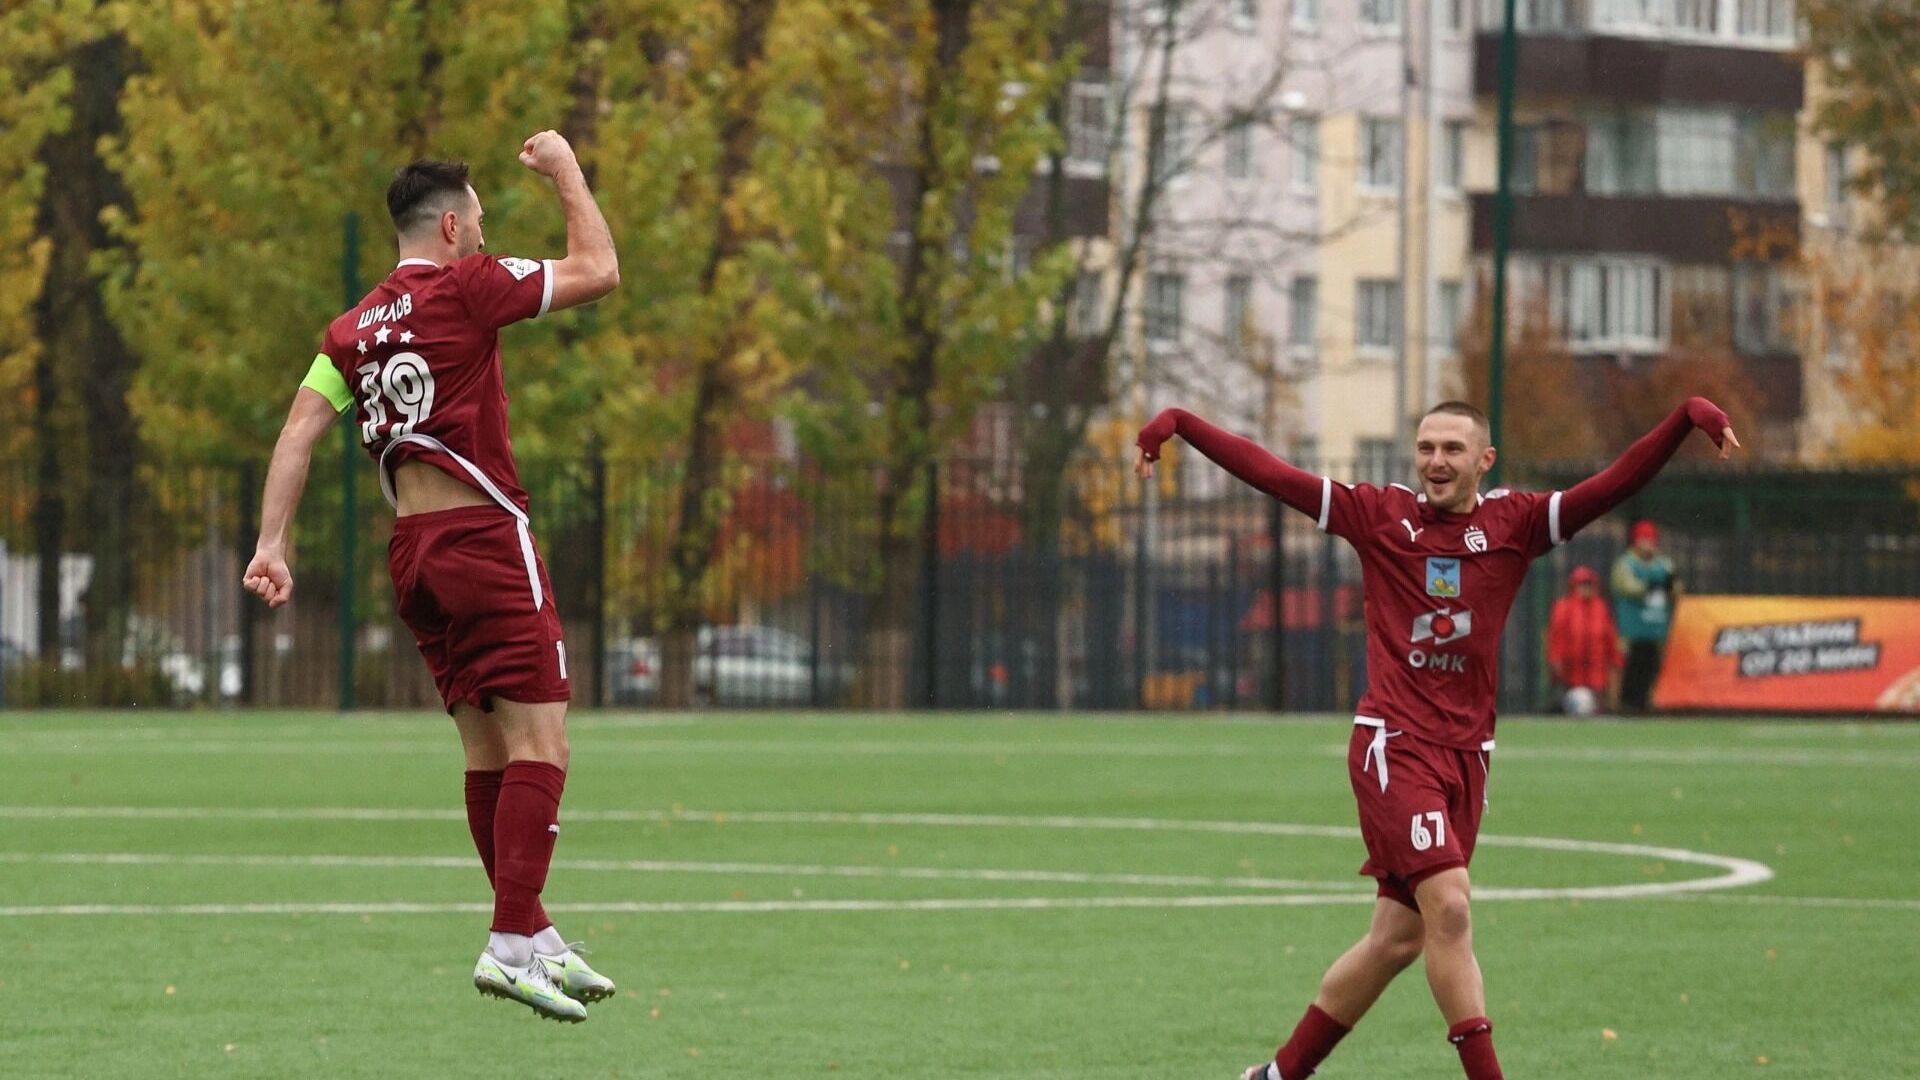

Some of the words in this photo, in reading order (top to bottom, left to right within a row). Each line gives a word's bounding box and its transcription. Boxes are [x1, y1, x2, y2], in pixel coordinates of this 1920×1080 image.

[356, 292, 413, 330] ШИЛОВ
[356, 352, 435, 444] 19
[1408, 649, 1467, 673] ОМК
[1410, 810, 1446, 851] 67
